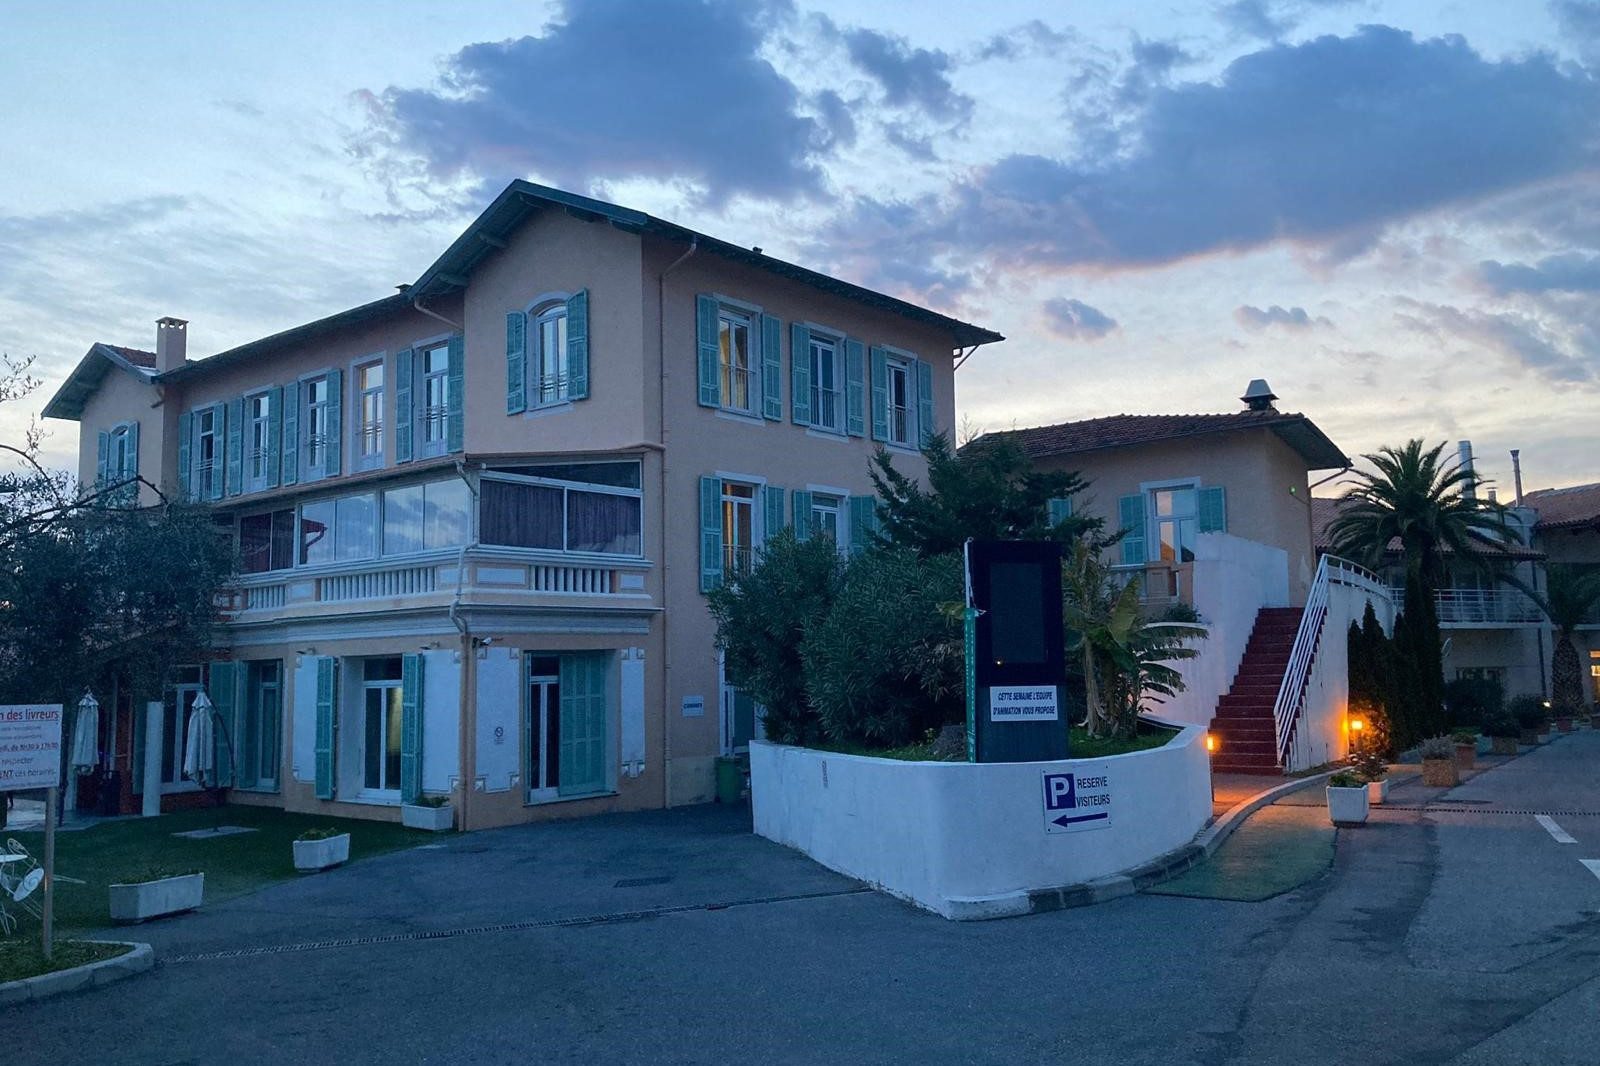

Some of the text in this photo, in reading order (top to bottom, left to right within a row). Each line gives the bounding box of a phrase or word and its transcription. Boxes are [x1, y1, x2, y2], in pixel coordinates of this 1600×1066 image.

[998, 692, 1012, 701] CETTE
[1013, 692, 1032, 701] SEMAINE
[7, 709, 22, 720] des
[26, 708, 58, 720] livreurs
[1022, 706, 1034, 715] VOUS
[1077, 776, 1108, 789] RESERVE
[1050, 777, 1070, 807] P
[1077, 794, 1110, 807] VISITEURS
